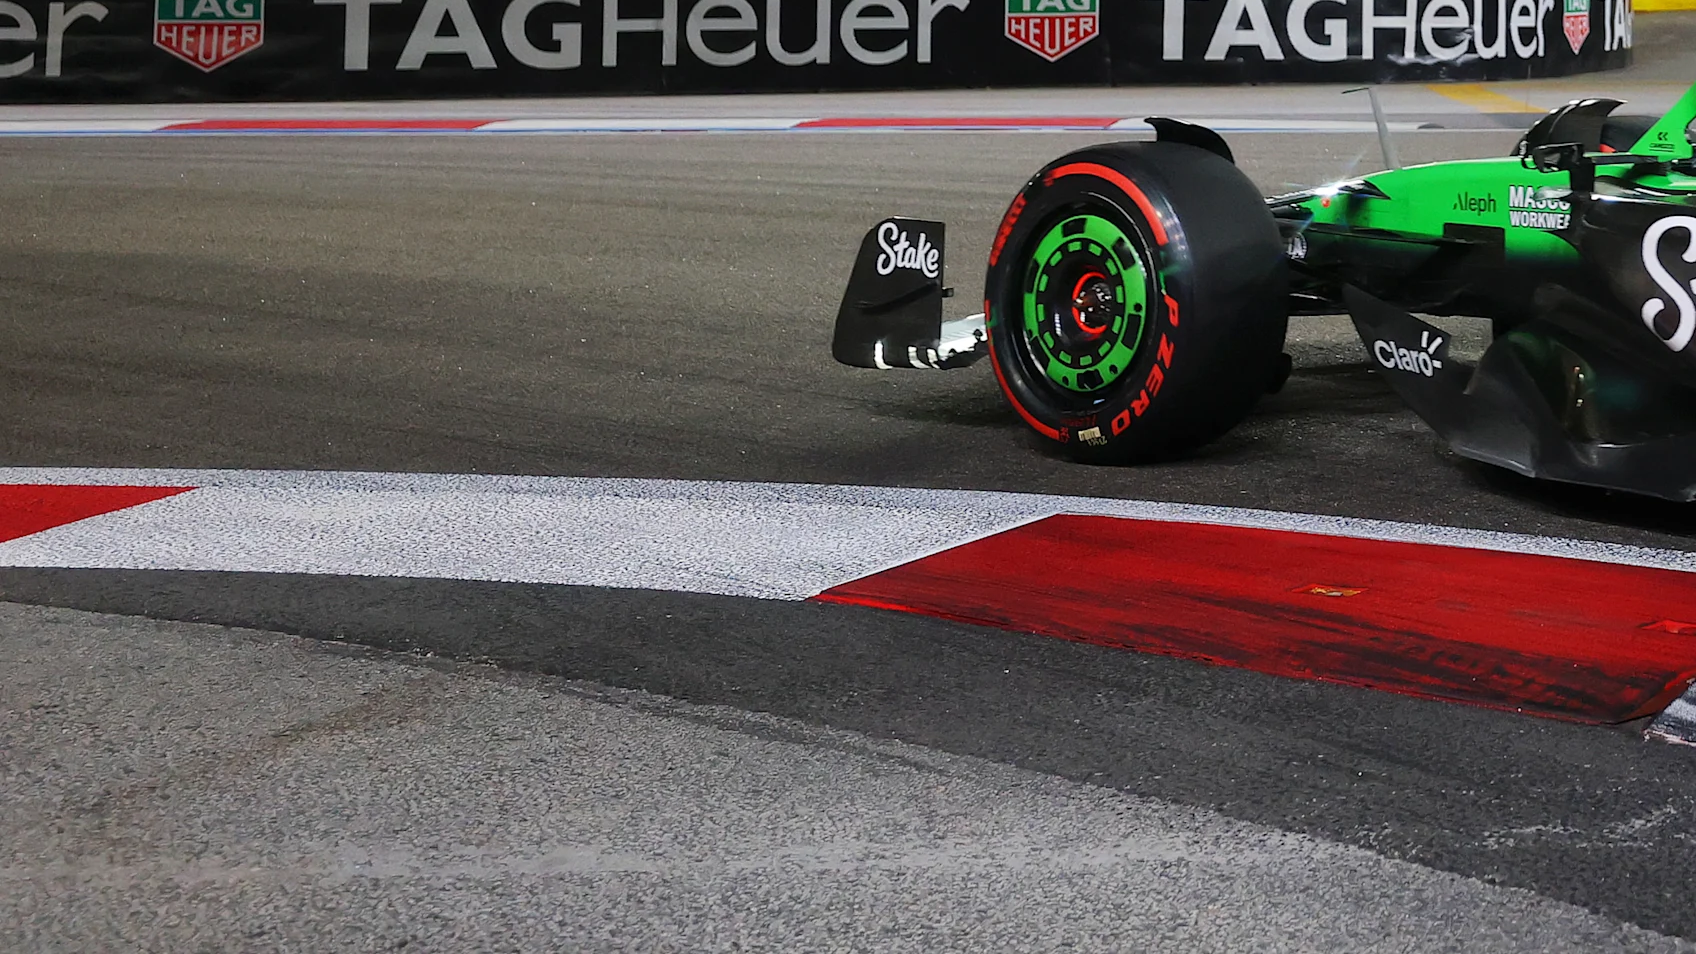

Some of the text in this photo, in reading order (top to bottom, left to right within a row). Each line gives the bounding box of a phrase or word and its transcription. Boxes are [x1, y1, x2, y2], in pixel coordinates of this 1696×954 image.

[161, 23, 261, 64] HEUER
[1010, 16, 1096, 57] HEUER
[1453, 191, 1497, 216] Aleph
[876, 221, 940, 278] Stake
[1111, 294, 1179, 436] P ZERO
[1373, 337, 1436, 378] Claro
